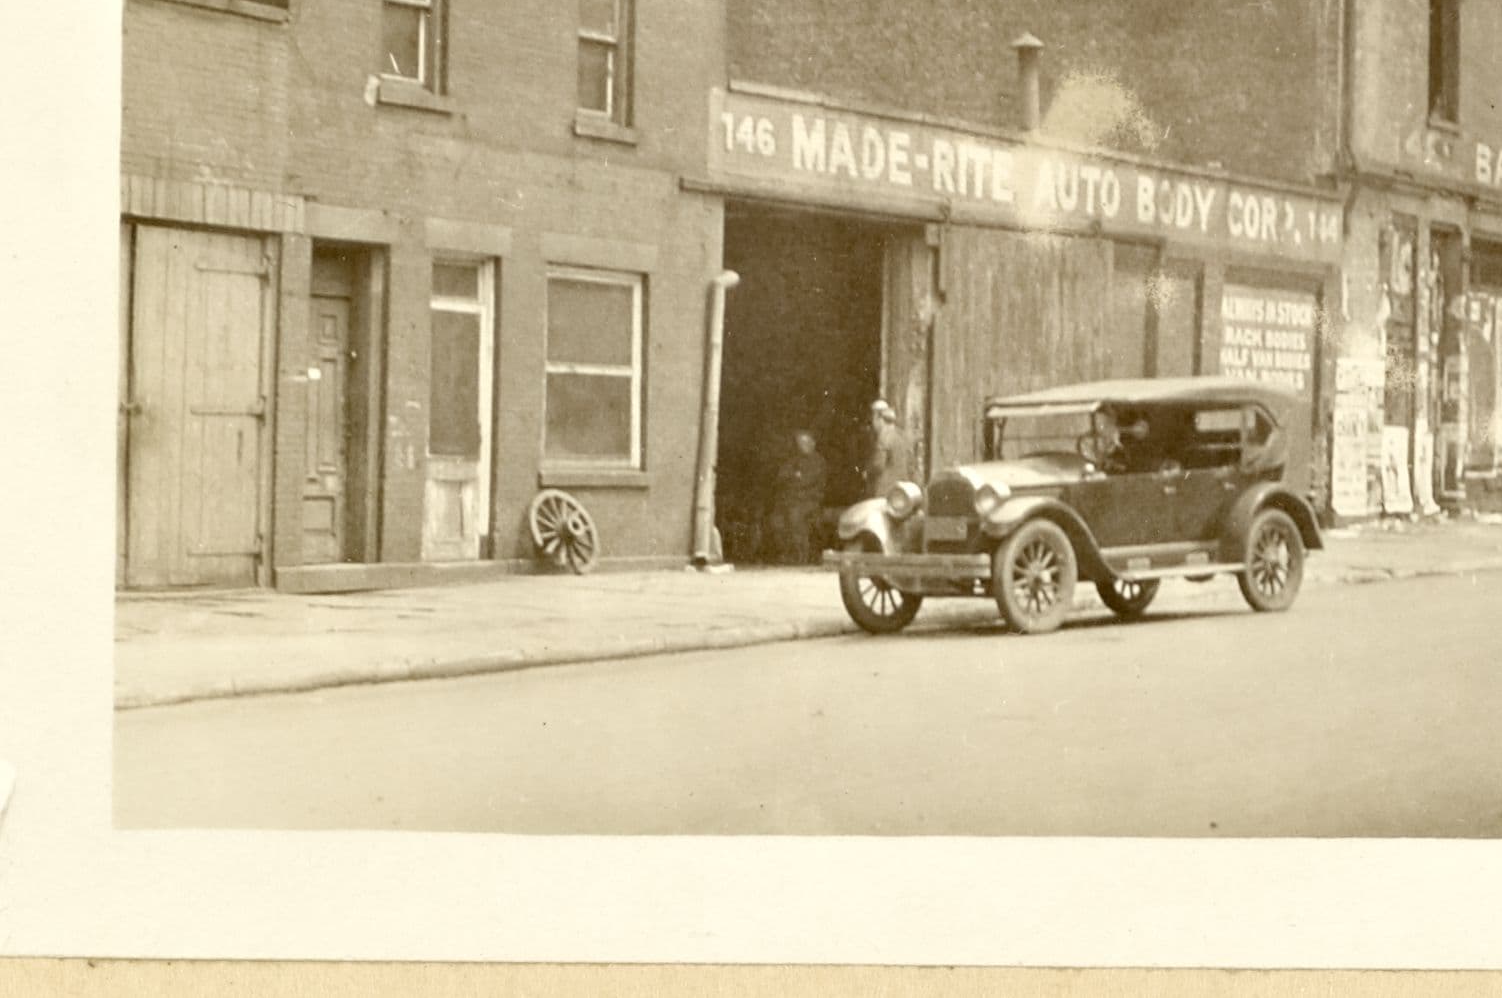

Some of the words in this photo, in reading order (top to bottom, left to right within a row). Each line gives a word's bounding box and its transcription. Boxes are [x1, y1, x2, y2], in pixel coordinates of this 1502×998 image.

[721, 111, 776, 157] 146
[792, 113, 1014, 202] MADE-RITE
[1034, 160, 1120, 218] AUTO
[1138, 174, 1216, 233] BODY
